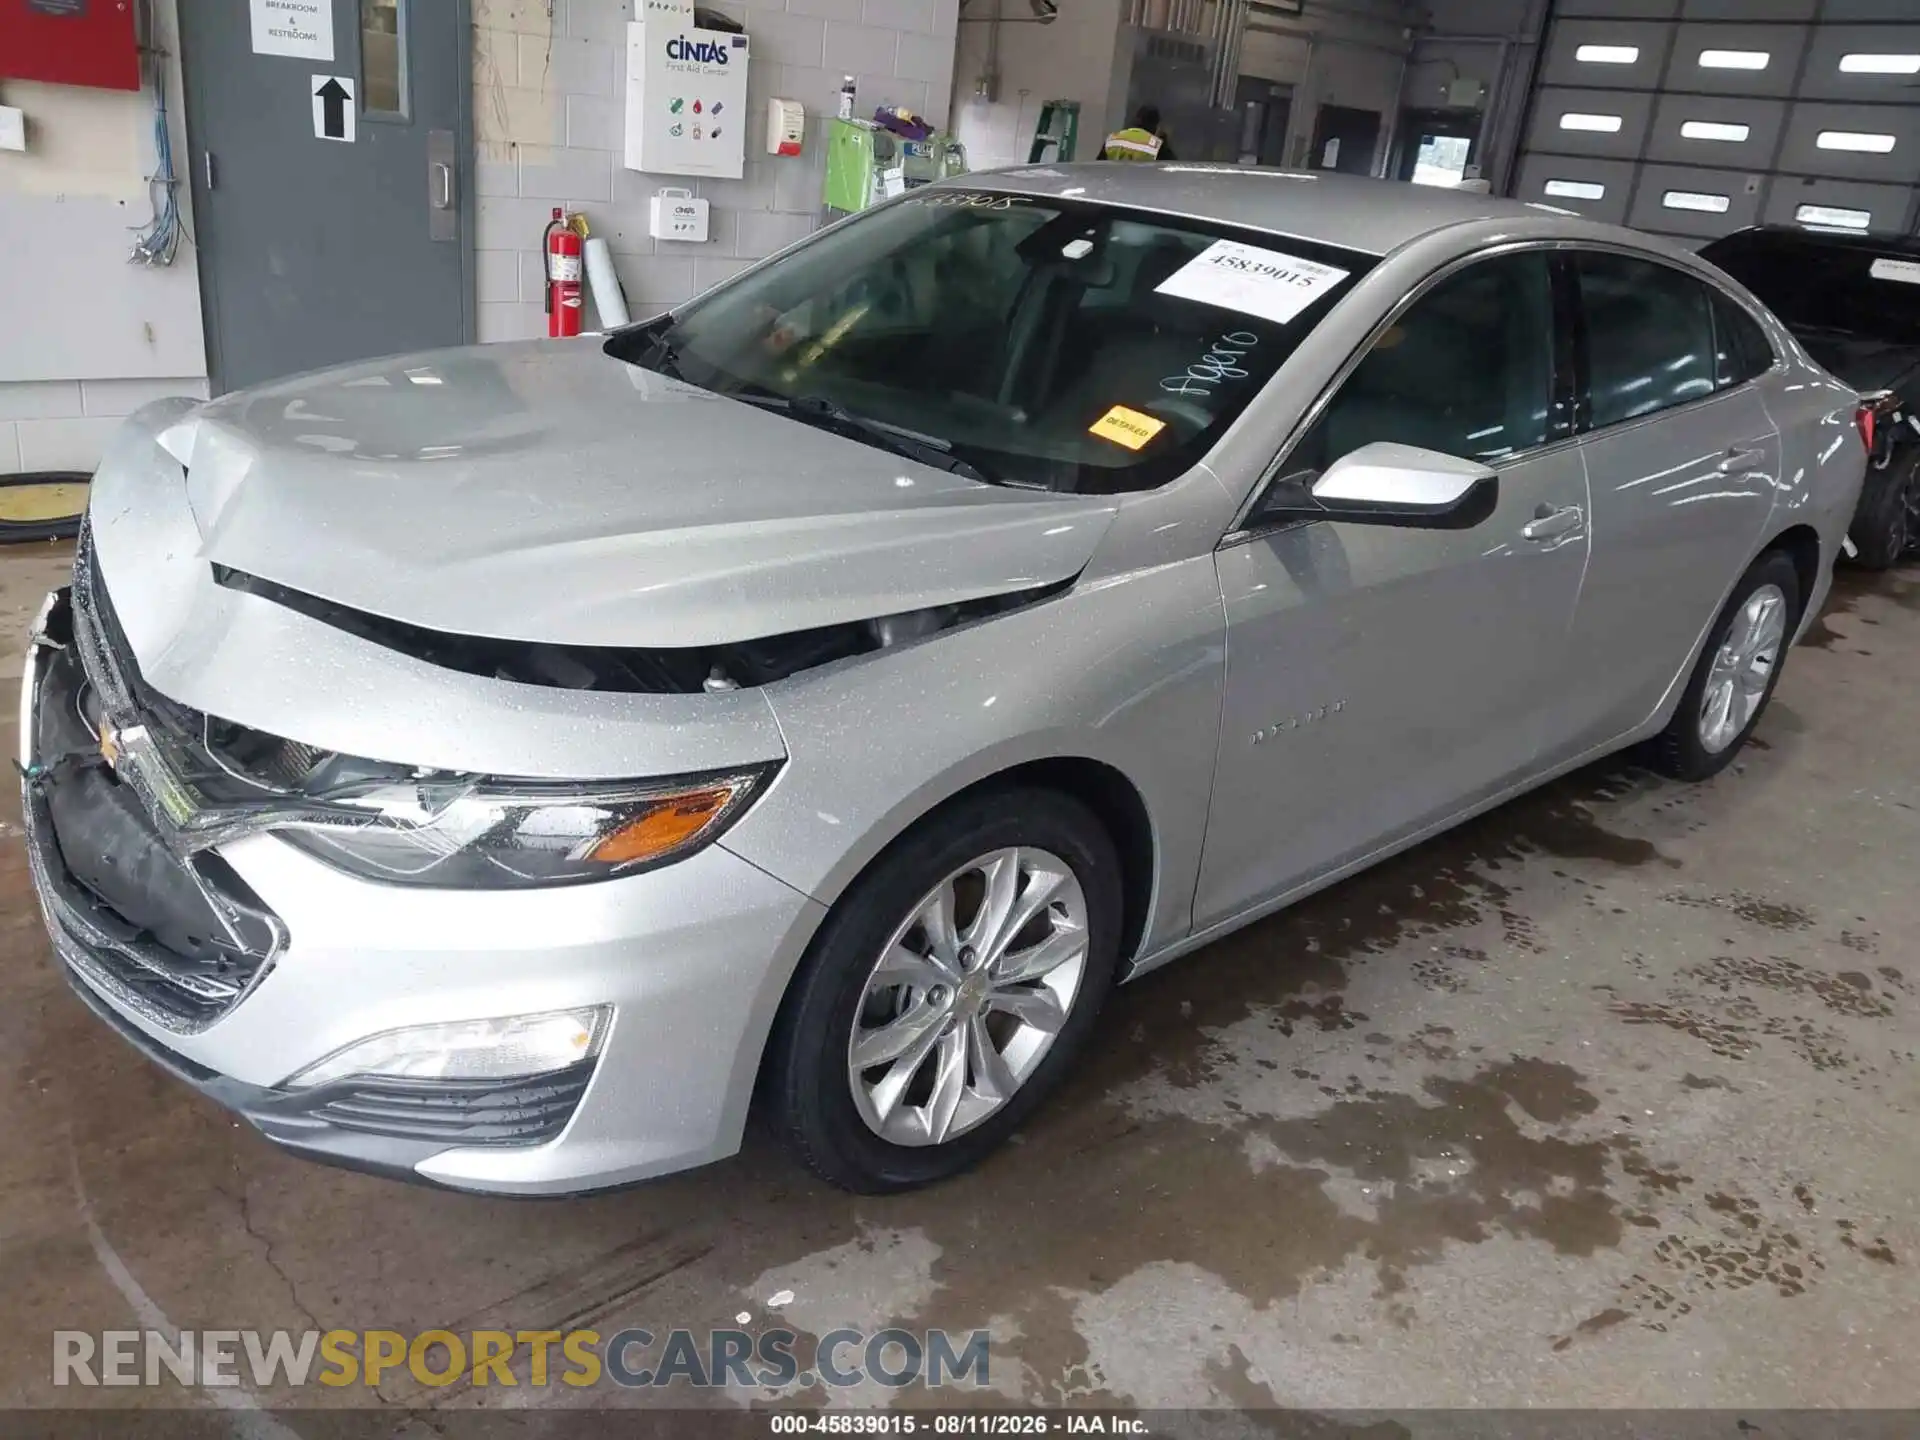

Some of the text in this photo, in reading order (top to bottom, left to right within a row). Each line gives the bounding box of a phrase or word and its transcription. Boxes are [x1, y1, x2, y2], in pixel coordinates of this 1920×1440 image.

[266, 1, 318, 13] BREAKROOM
[268, 28, 318, 41] RESTROOMS
[666, 34, 729, 65] CINTAS
[667, 62, 685, 72] First
[687, 64, 701, 74] Aid
[1209, 255, 1318, 287] 45839015
[1105, 416, 1149, 438] DETAILED
